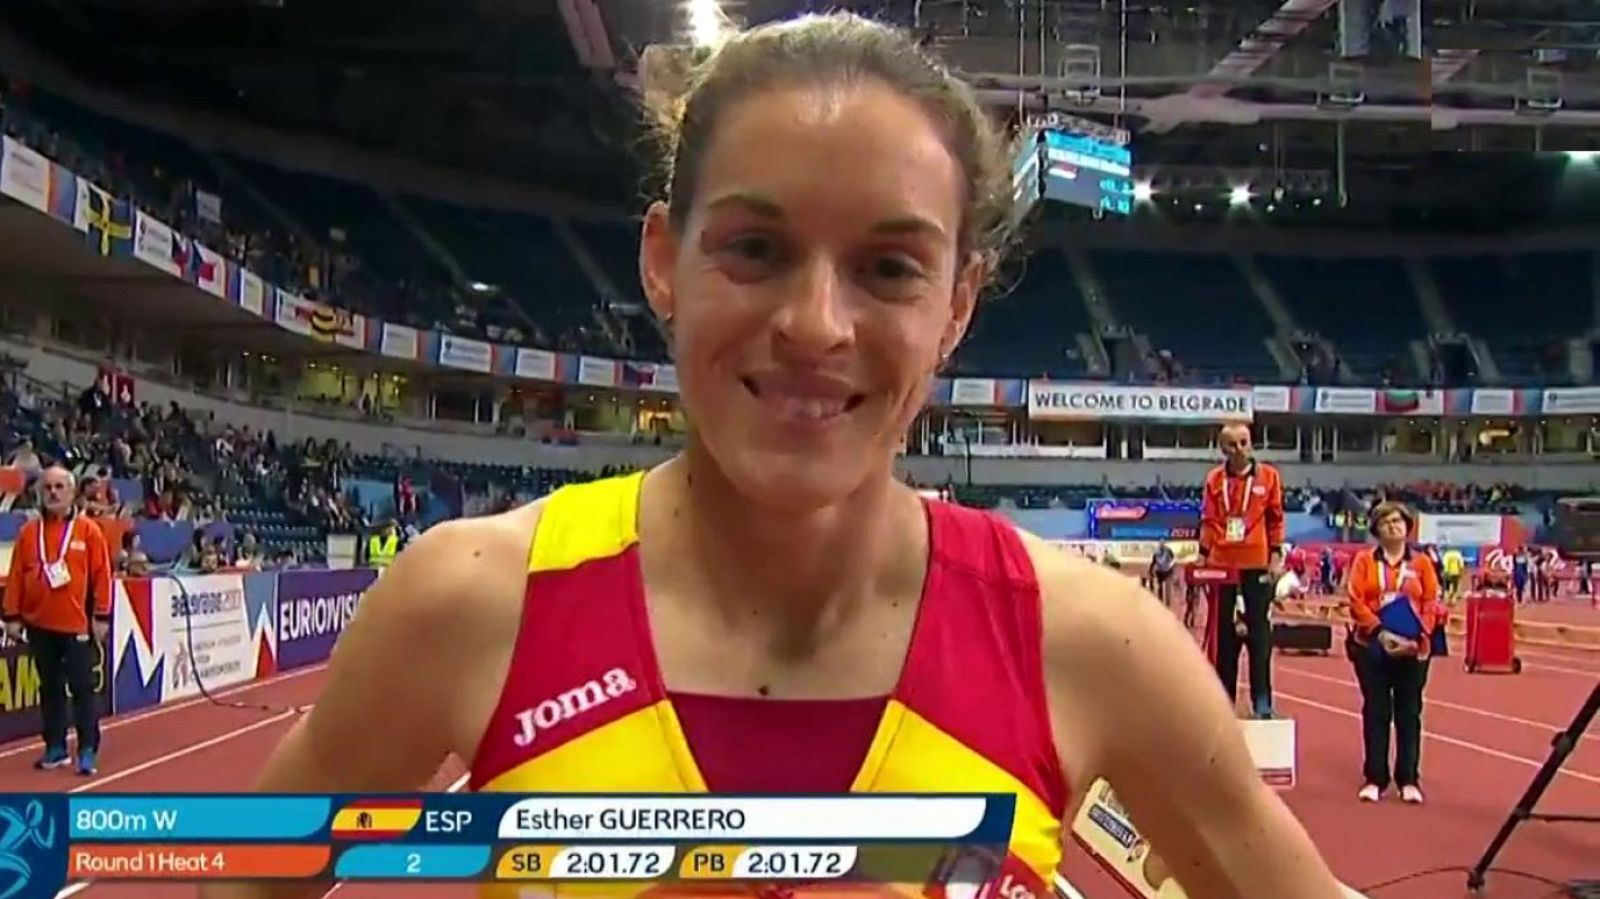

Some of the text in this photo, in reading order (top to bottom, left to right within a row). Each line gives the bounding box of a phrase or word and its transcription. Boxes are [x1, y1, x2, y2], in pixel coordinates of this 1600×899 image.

[1035, 392, 1246, 412] WELCOME TO BELGRADE
